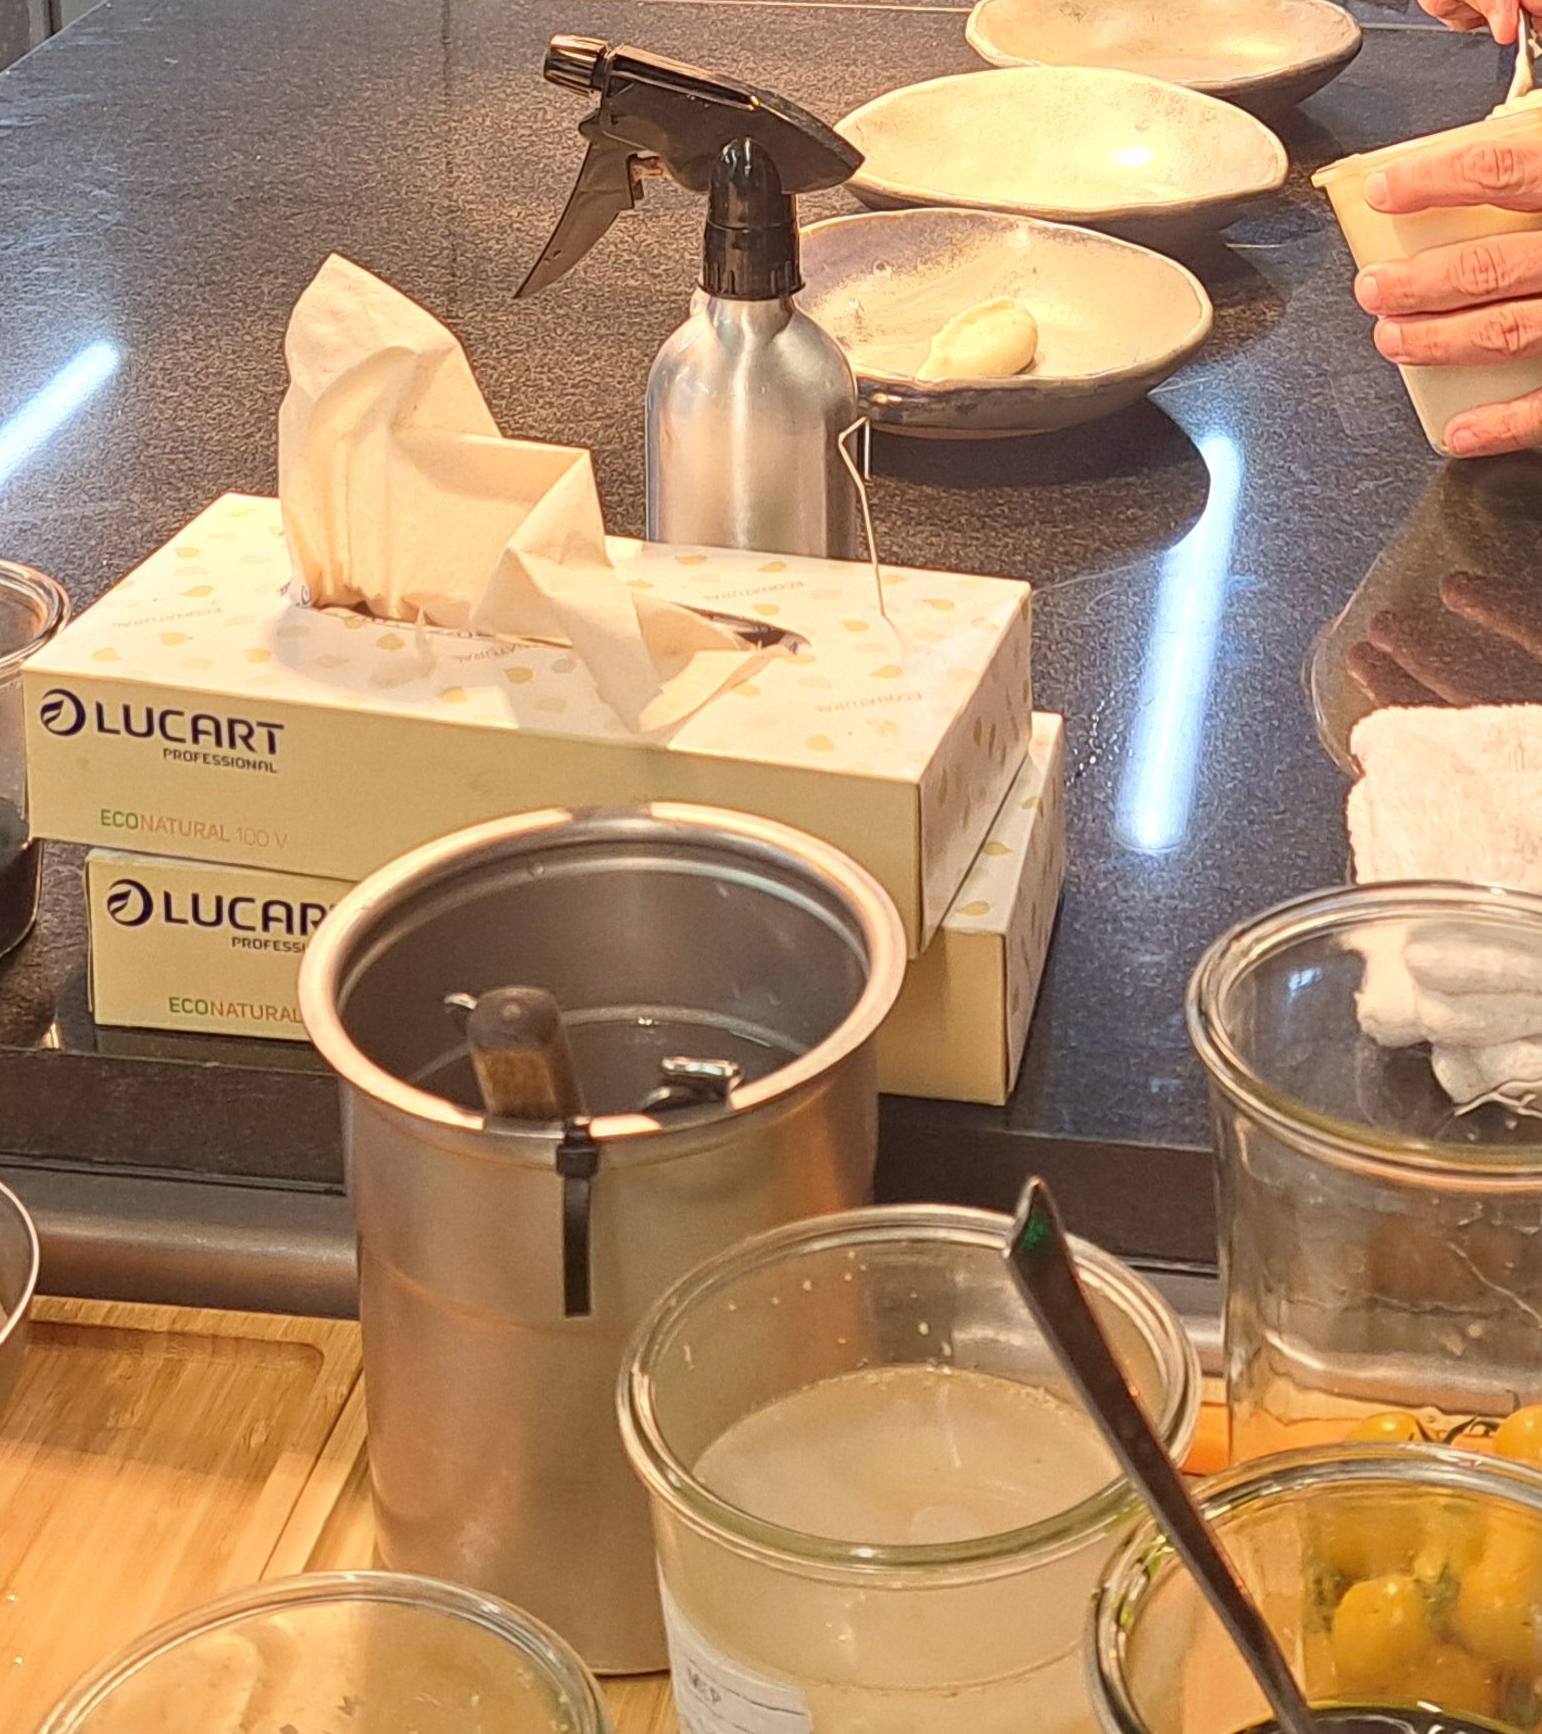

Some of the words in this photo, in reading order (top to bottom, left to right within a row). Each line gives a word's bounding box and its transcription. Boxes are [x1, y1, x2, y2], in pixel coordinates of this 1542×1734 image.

[96, 701, 284, 755] LUCART
[163, 747, 278, 774] PROFESSIONAL
[100, 809, 230, 842] ECONATURAL
[236, 827, 269, 846] 100
[274, 833, 288, 849] V
[164, 890, 335, 936] LUCAR
[231, 936, 307, 954] PROFESSI
